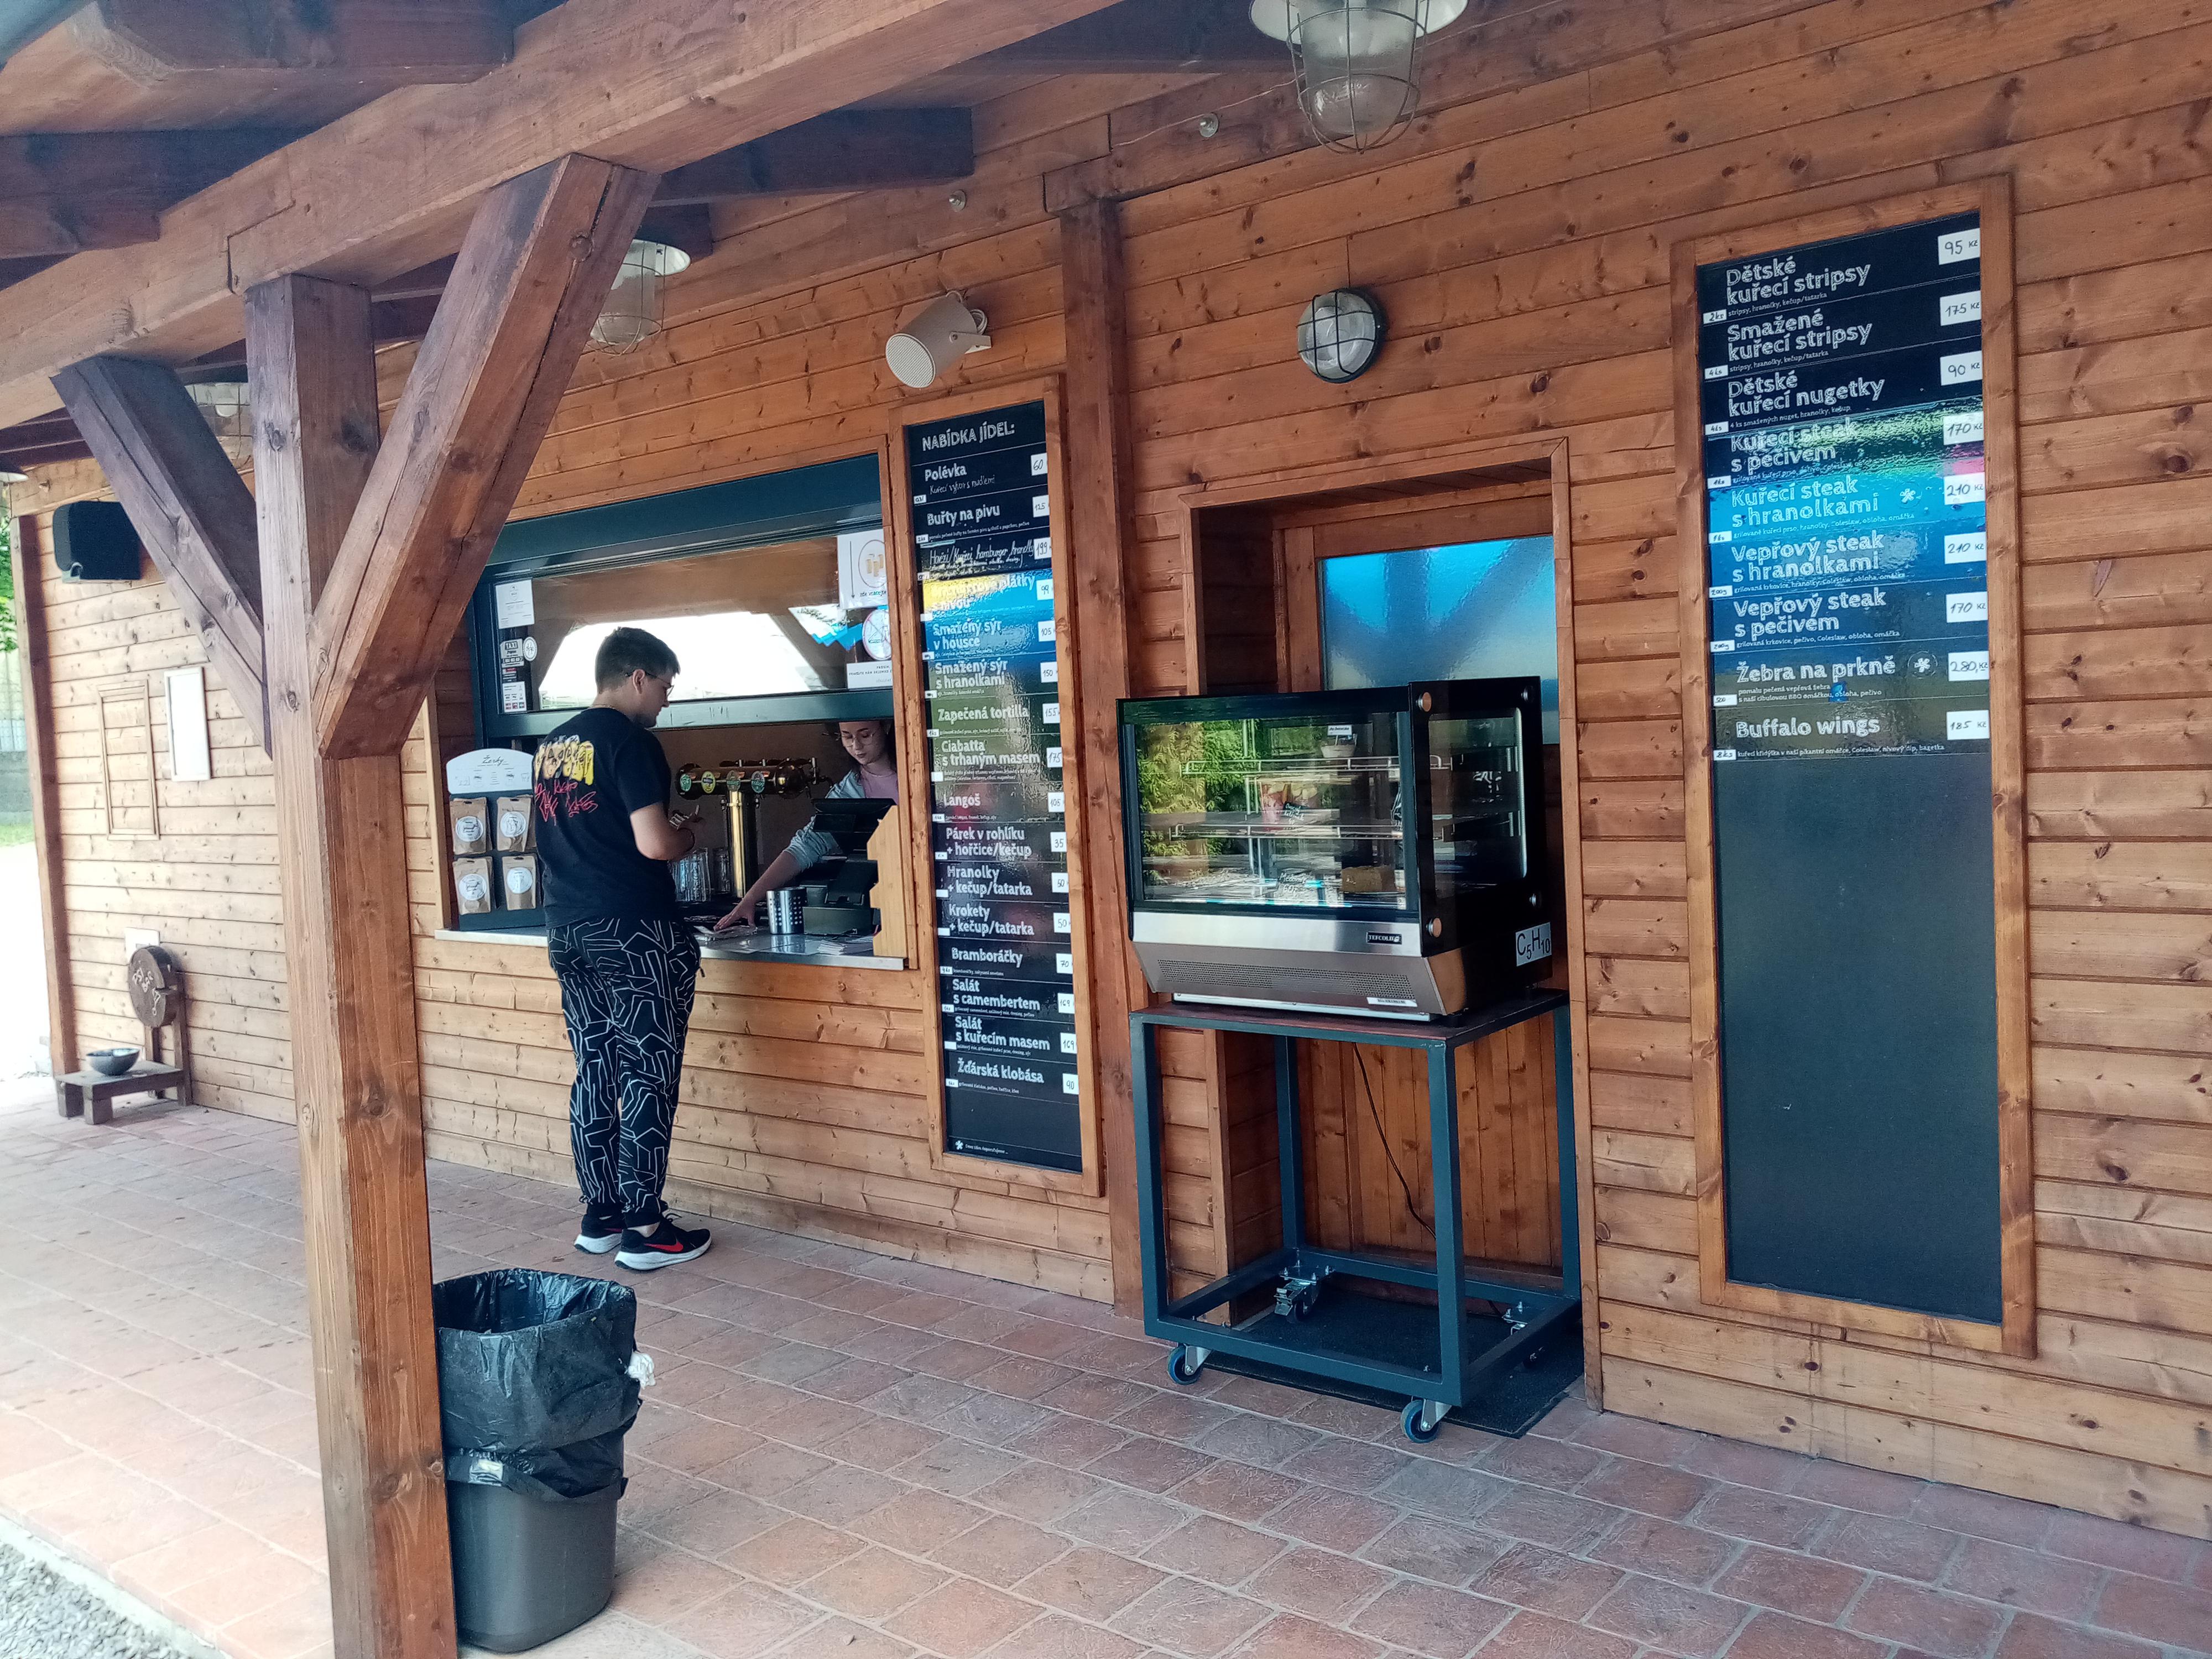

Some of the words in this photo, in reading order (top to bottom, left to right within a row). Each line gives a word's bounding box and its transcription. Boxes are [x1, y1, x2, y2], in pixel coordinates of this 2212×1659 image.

[1945, 239, 1963, 255] 95
[1726, 255, 1797, 286] Dětské
[1726, 276, 1790, 305] kuřecí
[1794, 264, 1871, 291] stripsy
[1945, 302, 1967, 317] 175
[1728, 308, 1824, 342] Smažené
[1728, 333, 1790, 361] kuřecí
[1796, 324, 1872, 348] stripsy
[1948, 364, 1965, 377] 90
[1728, 370, 1798, 398] Dětské
[1729, 390, 1791, 417] kuřecí
[1796, 377, 1885, 406] nugetky
[921, 428, 977, 451] NABÍDKA
[979, 421, 1015, 443] JÍDEL:
[1731, 424, 1795, 452] Kuřecí
[1799, 416, 1858, 444] steak
[1947, 421, 1971, 436] 170
[1033, 458, 1044, 471] 60
[1731, 458, 1743, 472] s
[1747, 445, 1836, 476] pečivem
[925, 463, 967, 482] Polévka
[1732, 482, 1796, 508] Kuřecí
[1801, 474, 1859, 500] steak
[1947, 482, 1970, 496] 210
[927, 510, 957, 527] Buřty
[959, 511, 974, 521] na
[975, 504, 1001, 523] pivu
[1035, 502, 1046, 512] 125
[1731, 514, 1743, 528] s
[1036, 541, 1048, 557] 199
[1731, 536, 1821, 566] Vepřový
[1826, 530, 1884, 555] steak
[1947, 542, 1971, 554] 210
[1733, 568, 1744, 582] s
[1749, 551, 1880, 581] hranolkami
[1733, 593, 1823, 620] Vepřový
[1828, 587, 1886, 610] steak
[1950, 602, 1972, 614] 170
[933, 619, 983, 637] Smažený
[985, 619, 1002, 636] sýr
[1040, 627, 1051, 637] 105
[1735, 623, 1746, 637] s
[1751, 614, 1839, 641] pečivem
[933, 640, 940, 650] v
[942, 636, 980, 650] housce
[935, 658, 989, 675] Smažený
[990, 657, 1009, 675] sýr
[1042, 669, 1053, 677] 150
[1736, 661, 1796, 683] Žebra
[1800, 663, 1827, 680] na
[1832, 655, 1896, 682] prkně
[936, 680, 943, 690] s
[943, 672, 1005, 689] hranolkami
[937, 706, 989, 724] Zapečená
[989, 705, 1030, 719] tortilla
[1045, 707, 1057, 717] 155
[1736, 717, 1812, 738] Buffalo
[1816, 716, 1880, 737] wings
[1950, 720, 1972, 730] 185
[941, 739, 986, 753] Ciabatta
[942, 758, 948, 766] s
[950, 752, 997, 769] trhaným
[999, 753, 1041, 764] masem
[1048, 752, 1062, 764] 175
[943, 793, 982, 809] Langoš
[1050, 798, 1061, 807] 105
[946, 826, 975, 840] Párek
[977, 830, 984, 840] v
[986, 826, 1025, 840] rohlíku
[955, 841, 1032, 859] hořčice/kečup
[1055, 839, 1065, 848] 35
[947, 865, 999, 883] Hranolky
[955, 878, 1033, 898] kečup/tatarka
[1057, 879, 1065, 888] 50
[948, 903, 990, 922] Krokety
[957, 919, 1035, 937] kečup/tatarka
[1057, 919, 1067, 928] 50
[952, 947, 1022, 968] Bramboráčky
[1060, 959, 1070, 968] 70
[952, 978, 980, 992] Salát
[953, 994, 959, 1004] s
[961, 994, 1041, 1011] camembertem
[1060, 999, 1071, 1008] 169
[955, 1015, 982, 1030] Salát
[956, 1031, 962, 1041] s
[964, 1029, 1007, 1046] kuřecím
[1009, 1036, 1051, 1051] masem
[1063, 1040, 1075, 1051] 169
[957, 1057, 1000, 1078] Žďárská
[1001, 1065, 1045, 1083] klobása
[1066, 1079, 1075, 1090] 90
